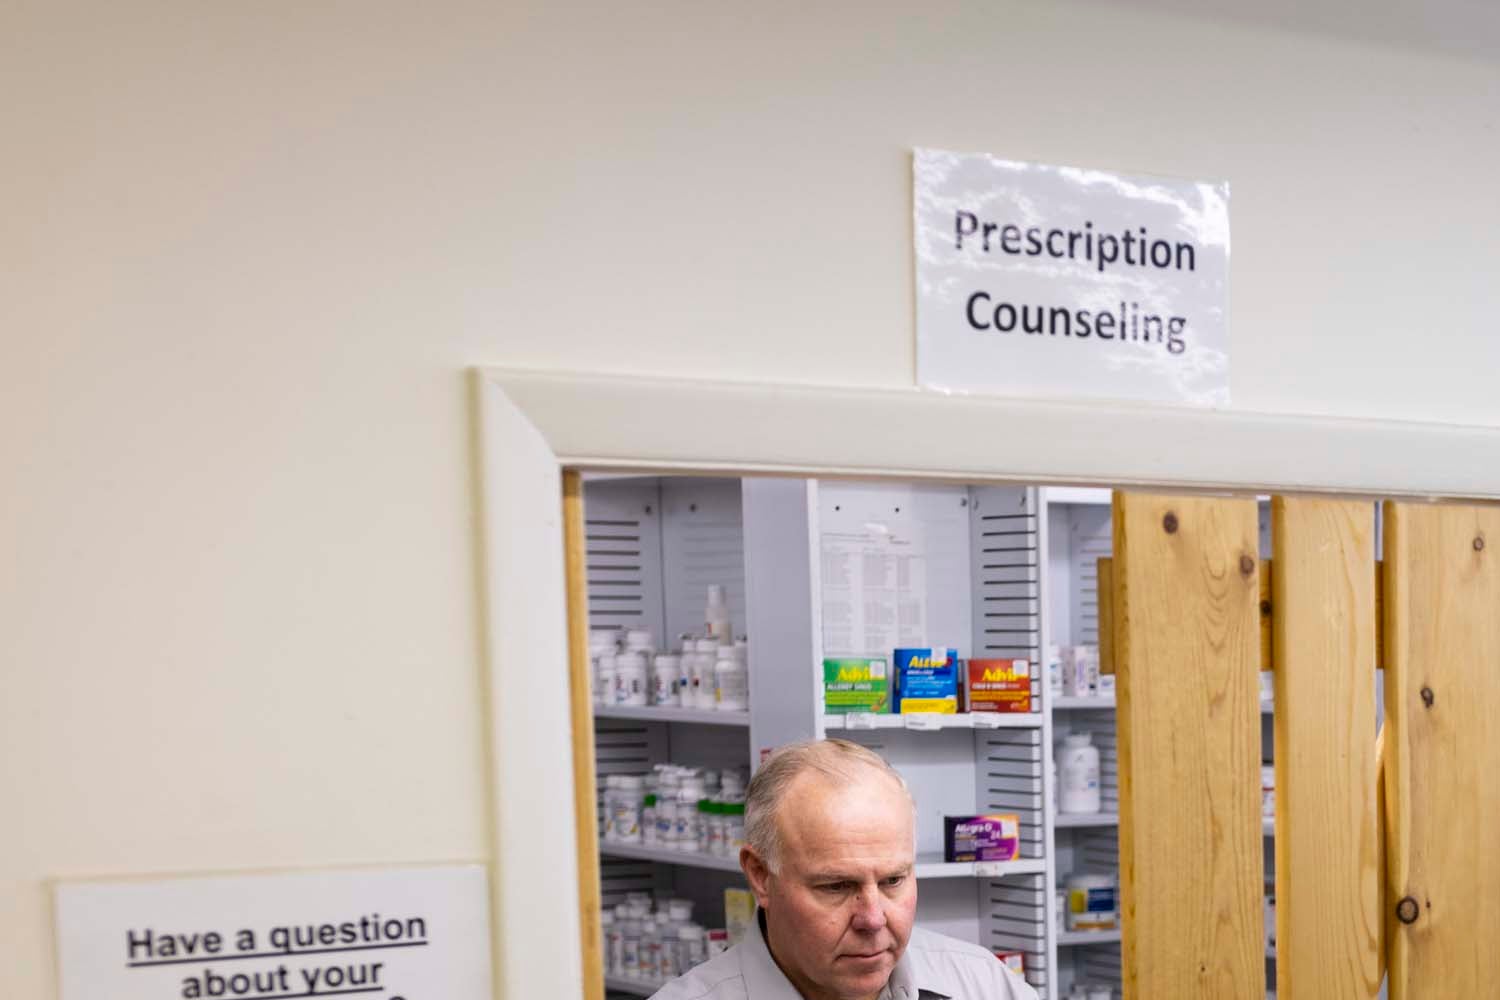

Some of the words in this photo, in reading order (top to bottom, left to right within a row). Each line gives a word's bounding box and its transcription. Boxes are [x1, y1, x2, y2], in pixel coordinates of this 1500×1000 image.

[954, 209, 1196, 272] Prescription
[965, 290, 1187, 354] Counseling
[126, 928, 222, 963] Have
[235, 928, 257, 953] a
[269, 914, 428, 955] question
[301, 961, 384, 998] your
